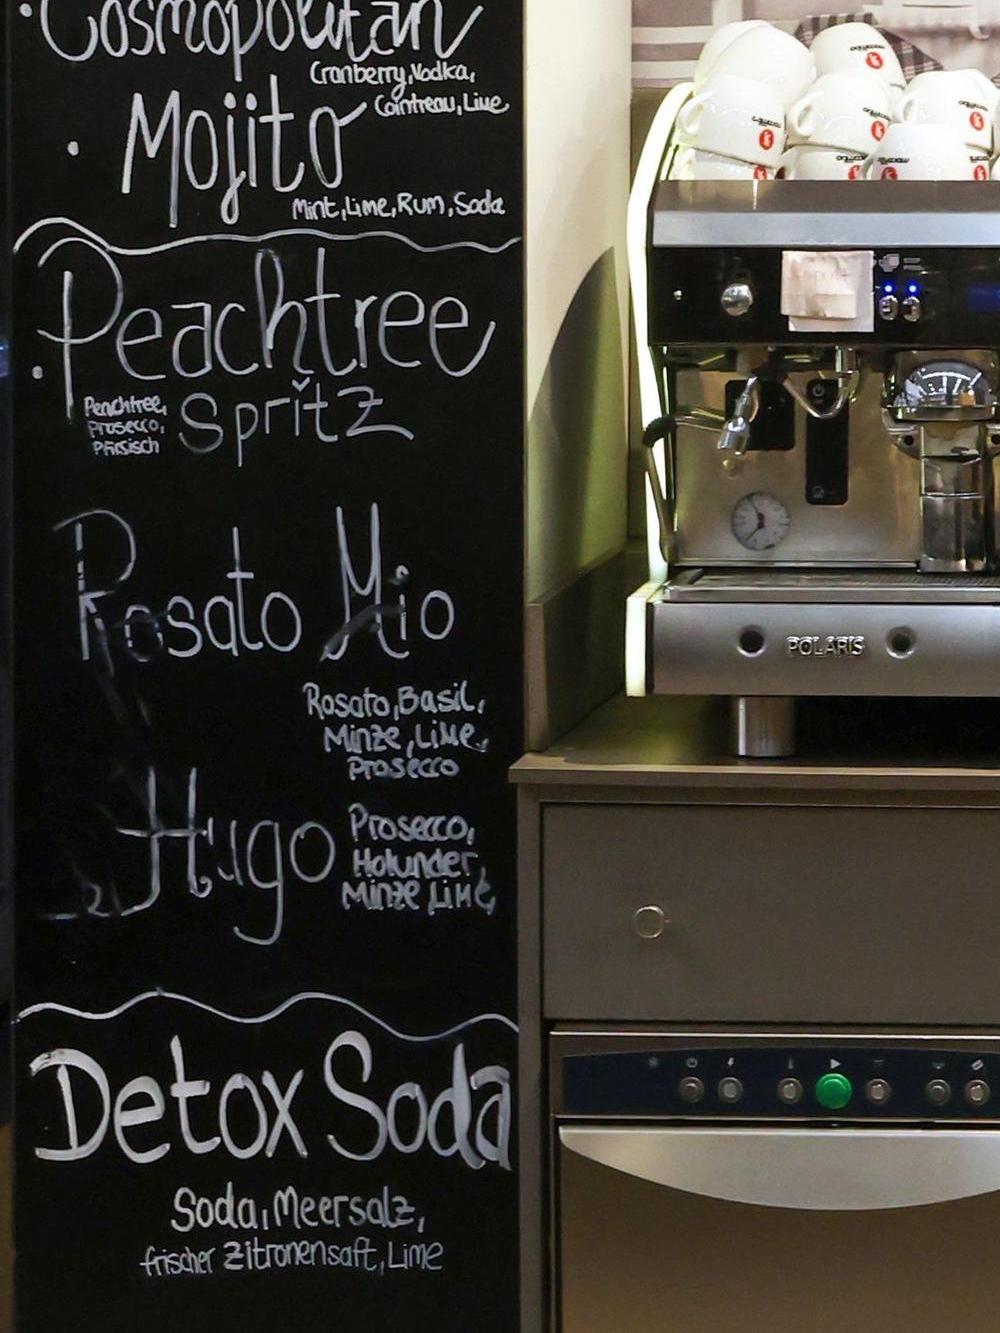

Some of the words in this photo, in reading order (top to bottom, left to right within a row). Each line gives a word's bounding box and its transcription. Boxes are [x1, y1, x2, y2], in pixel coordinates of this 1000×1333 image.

[122, 74, 367, 227] Mojito
[454, 189, 505, 216] Soda
[37, 237, 496, 423] Peachtree
[54, 509, 302, 669] Rosato
[321, 503, 454, 662] Mio
[786, 634, 866, 657] POLARIS
[303, 682, 399, 720] Rosato,
[398, 680, 486, 714] Basil,
[347, 755, 460, 781] Prosecco
[30, 1035, 308, 1163] Detox
[324, 1030, 512, 1171] Soda
[171, 1181, 269, 1232] Soda,
[273, 1185, 425, 1233] Meersalz,
[139, 1245, 216, 1276] frischer
[388, 1241, 444, 1270] Lime
